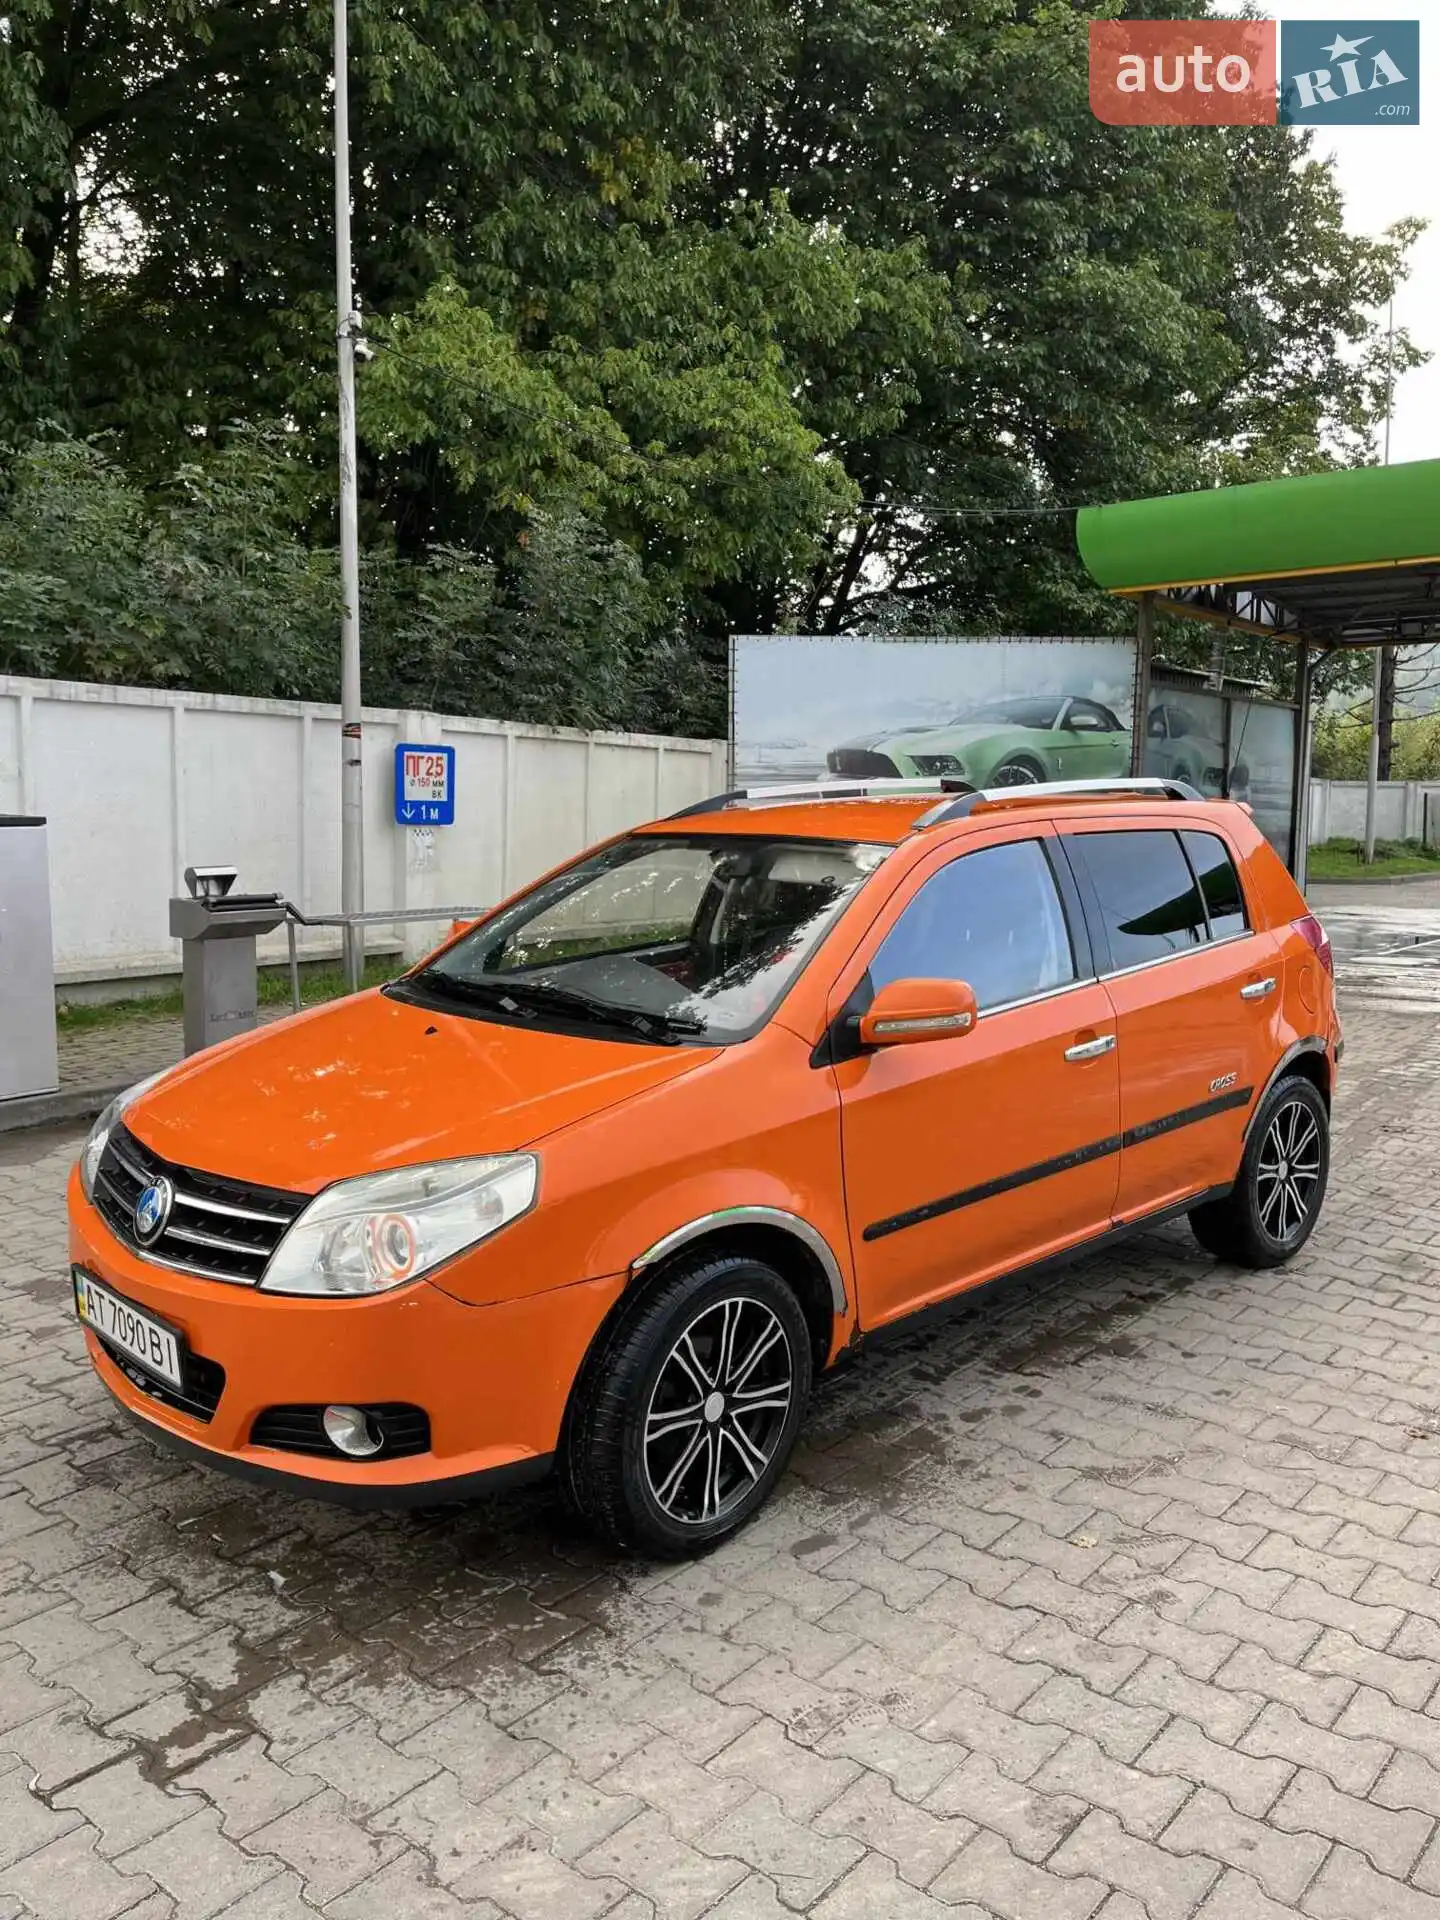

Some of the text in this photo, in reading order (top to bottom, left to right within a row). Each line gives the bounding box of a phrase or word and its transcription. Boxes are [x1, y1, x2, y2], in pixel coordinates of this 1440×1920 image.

[86, 1284, 174, 1375] AT 7090 BI
